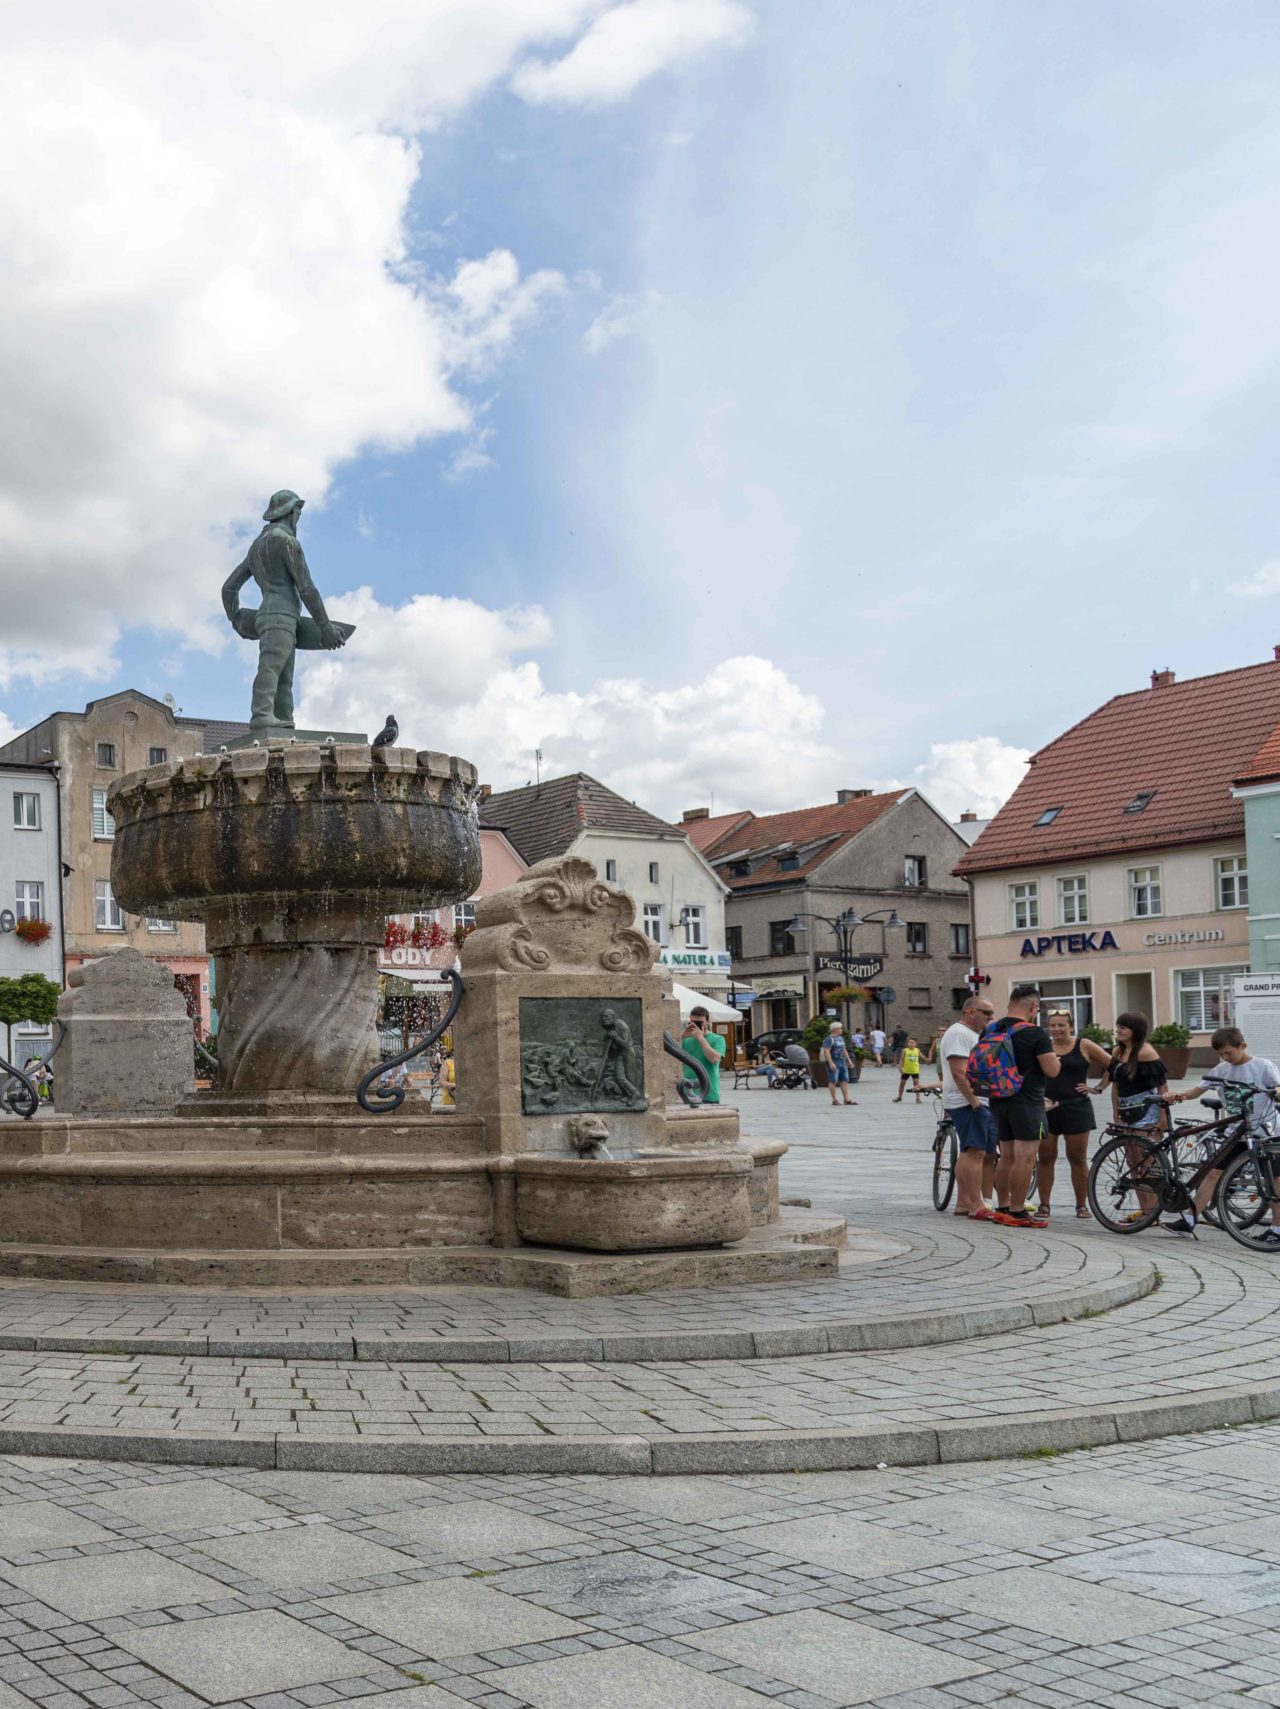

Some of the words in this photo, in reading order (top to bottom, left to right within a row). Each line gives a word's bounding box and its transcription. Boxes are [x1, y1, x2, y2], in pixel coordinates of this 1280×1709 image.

[1020, 931, 1119, 957] APTEKA
[1142, 928, 1224, 946] Centrum
[378, 947, 435, 965] LODY
[672, 954, 715, 966] NATURA
